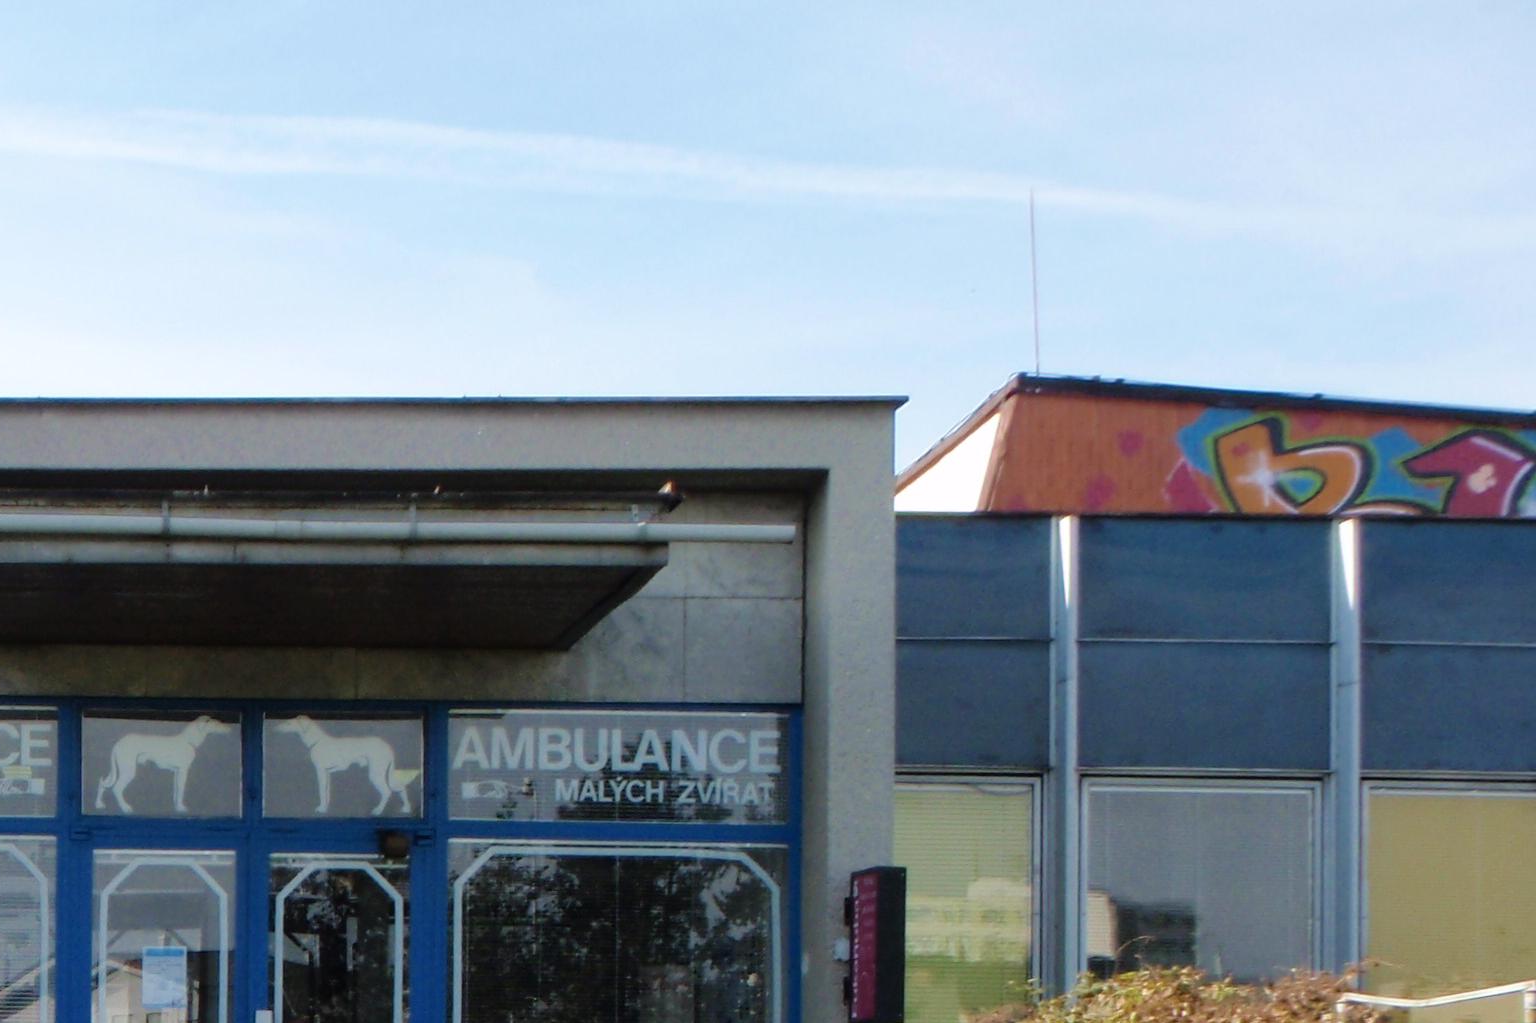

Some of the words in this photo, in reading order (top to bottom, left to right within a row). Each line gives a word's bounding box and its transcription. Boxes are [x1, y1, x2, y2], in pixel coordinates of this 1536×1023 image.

[452, 725, 782, 774] AMBULANCE
[554, 776, 664, 803] MALÝCH
[677, 776, 776, 805] ZVÍŘAT
